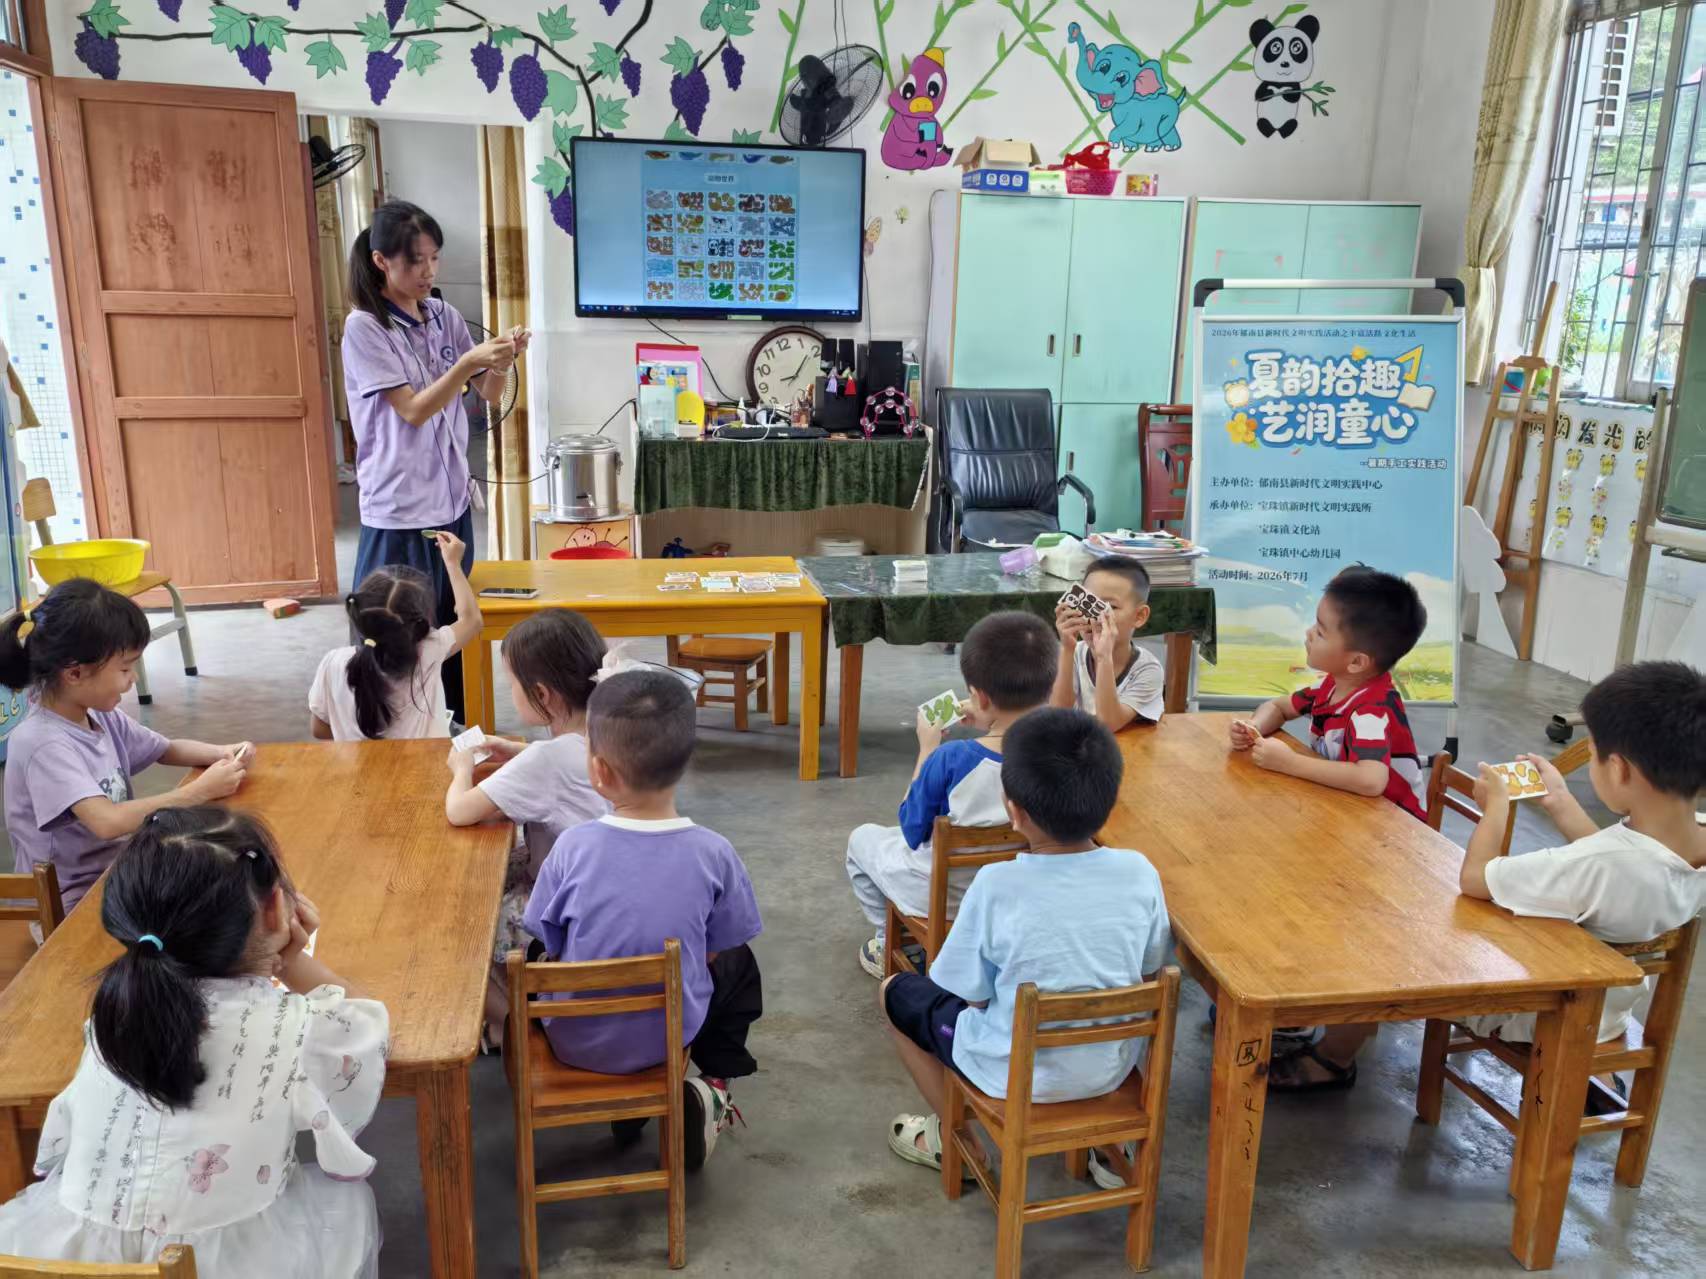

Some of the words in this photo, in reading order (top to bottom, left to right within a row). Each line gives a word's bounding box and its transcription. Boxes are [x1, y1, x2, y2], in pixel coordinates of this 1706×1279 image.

[776, 337, 791, 351] 12
[797, 337, 804, 349] 1
[763, 347, 776, 360] 11
[811, 344, 822, 358] 2
[756, 363, 771, 378] 10
[1247, 351, 1401, 399] 夏韵拾趣
[758, 382, 769, 394] 9
[1259, 397, 1415, 445] 艺润童心
